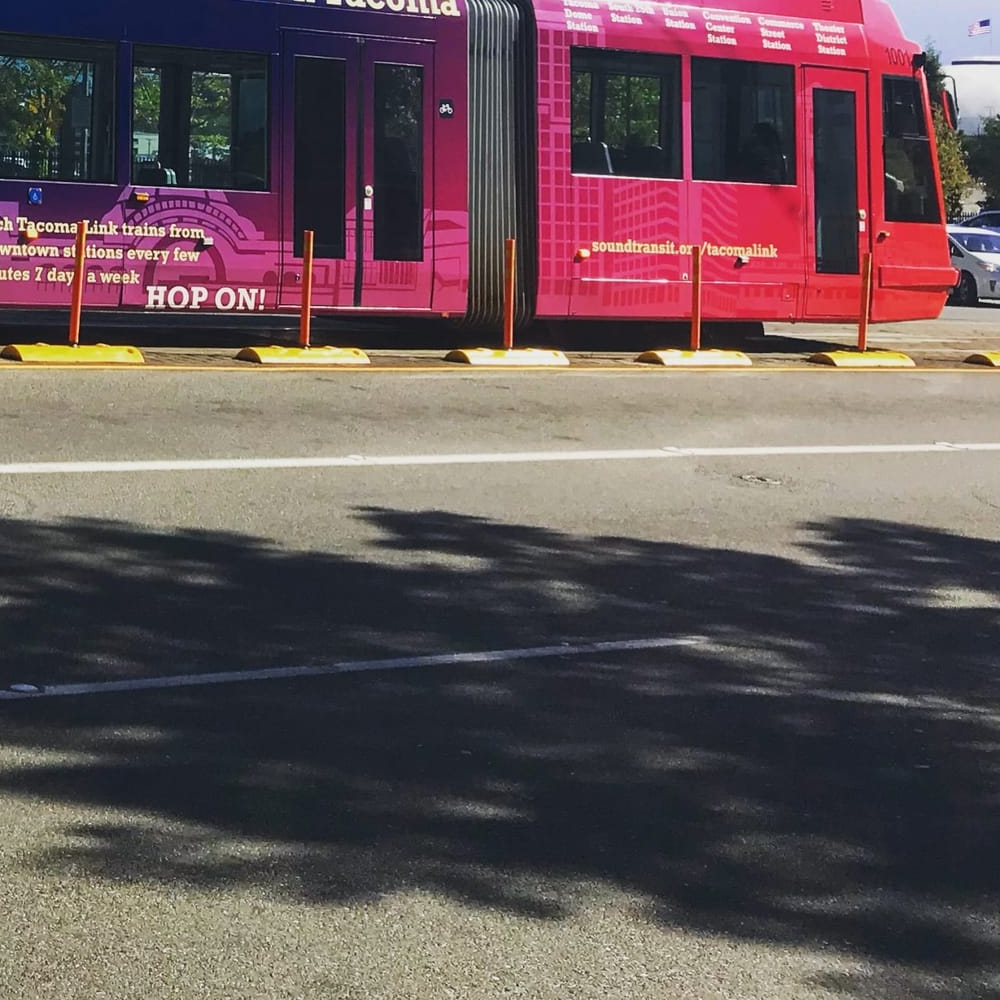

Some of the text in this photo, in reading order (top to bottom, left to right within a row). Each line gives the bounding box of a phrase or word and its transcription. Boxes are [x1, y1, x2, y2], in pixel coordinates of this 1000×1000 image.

[610, 13, 643, 25] Station
[664, 18, 696, 30] Station
[702, 11, 752, 25] Convention
[758, 16, 805, 30] Commerce
[566, 21, 599, 33] Station
[705, 22, 735, 34] Center
[813, 22, 845, 34] Theater
[760, 28, 785, 39] Street
[815, 33, 848, 45] District
[707, 34, 737, 46] Station
[763, 39, 792, 51] Station
[817, 44, 846, 56] Station
[17, 217, 78, 235] Tacoma
[83, 219, 118, 235] Link
[122, 222, 166, 237] trains
[169, 224, 205, 239] from
[63, 244, 123, 260] sttions
[127, 247, 168, 265] every
[173, 247, 201, 262] few
[592, 239, 778, 258] soundtransit.or/tacomalink
[35, 267, 43, 281] 7
[47, 267, 76, 287] day
[87, 271, 96, 283] a
[100, 270, 140, 284] week
[145, 285, 266, 310] HOP ON!
